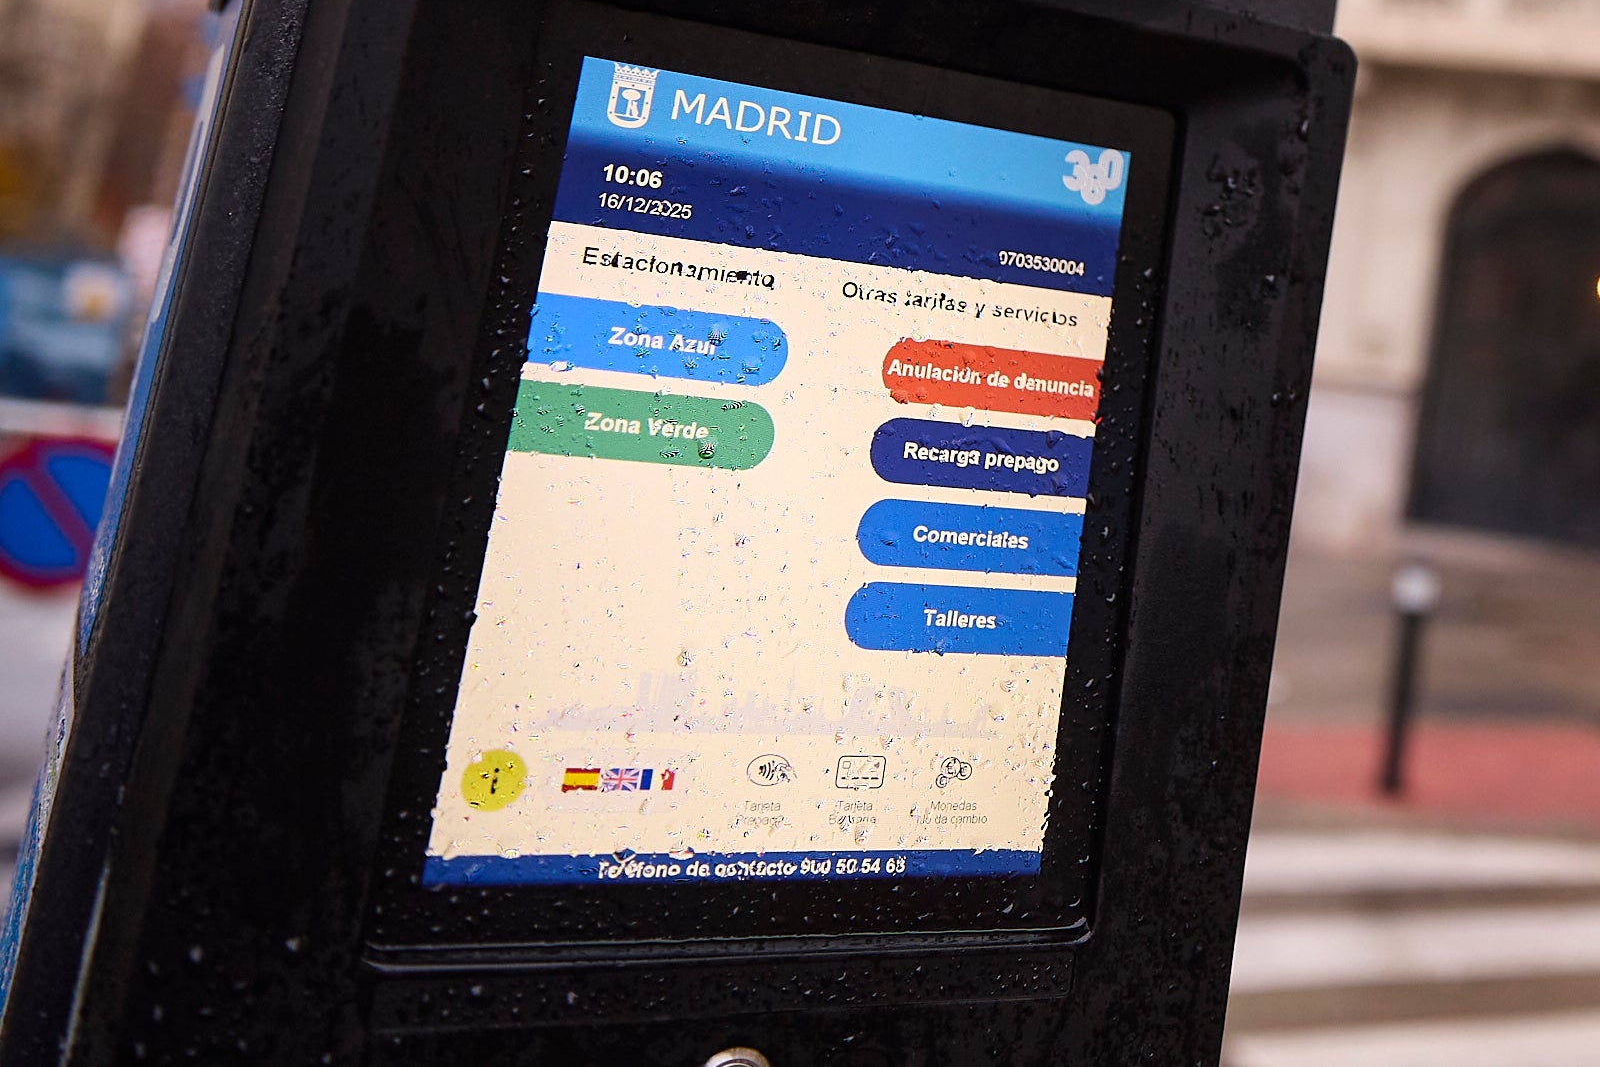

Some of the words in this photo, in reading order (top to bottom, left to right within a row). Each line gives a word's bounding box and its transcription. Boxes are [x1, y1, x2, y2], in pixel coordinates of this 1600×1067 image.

[670, 89, 841, 145] MADRID
[603, 163, 663, 189] 10:06
[598, 192, 693, 220] 16/12/2025
[998, 250, 1085, 277] 0703530004
[607, 326, 664, 350] Zona
[986, 370, 1010, 388] de
[1013, 371, 1095, 398] denuncia
[584, 412, 641, 435] Zona
[647, 417, 709, 440] Verde
[902, 441, 980, 467] Recarga
[984, 450, 1060, 475] prepago
[912, 524, 1029, 550] Comerciales
[922, 608, 997, 630] Talleres
[930, 800, 977, 812] Monedas
[934, 813, 947, 824] da
[950, 813, 988, 825] cambio
[861, 858, 881, 874] 54
